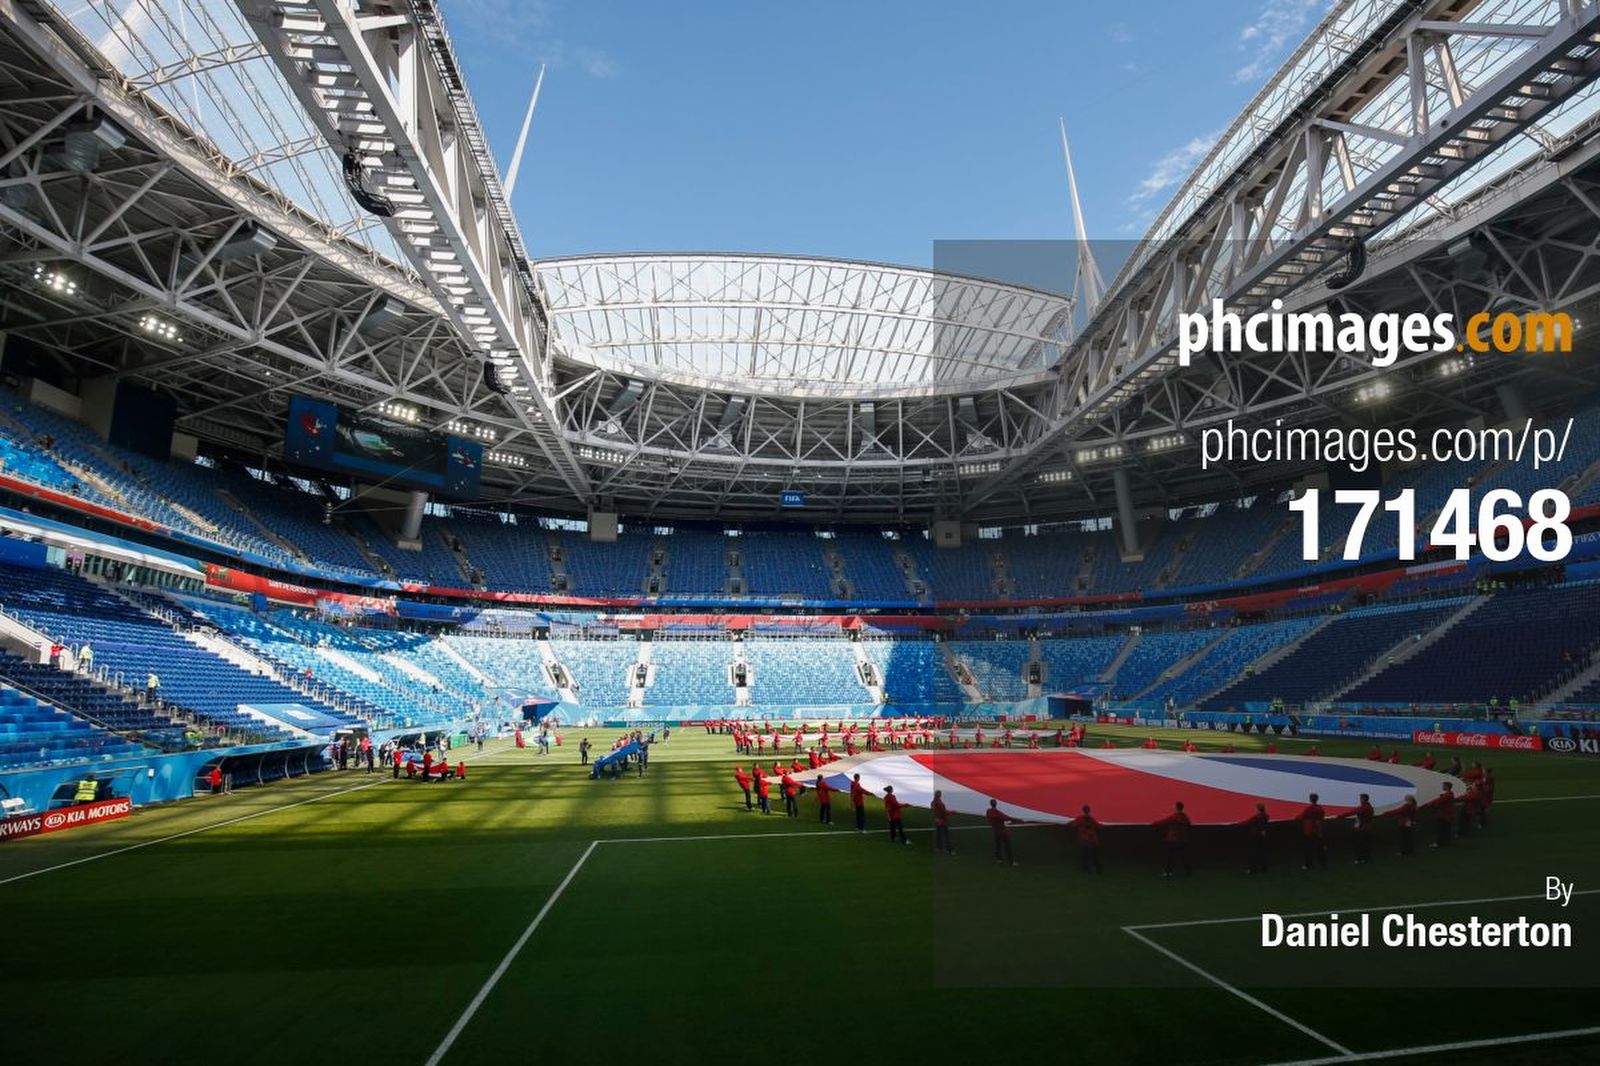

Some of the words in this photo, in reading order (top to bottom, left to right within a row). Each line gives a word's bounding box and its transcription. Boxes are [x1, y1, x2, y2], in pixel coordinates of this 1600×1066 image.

[1552, 740, 1573, 750] KIA
[1579, 739, 1598, 753] KI
[47, 815, 64, 826] KIA
[67, 811, 86, 823] KIA
[87, 801, 130, 819] MOTORS
